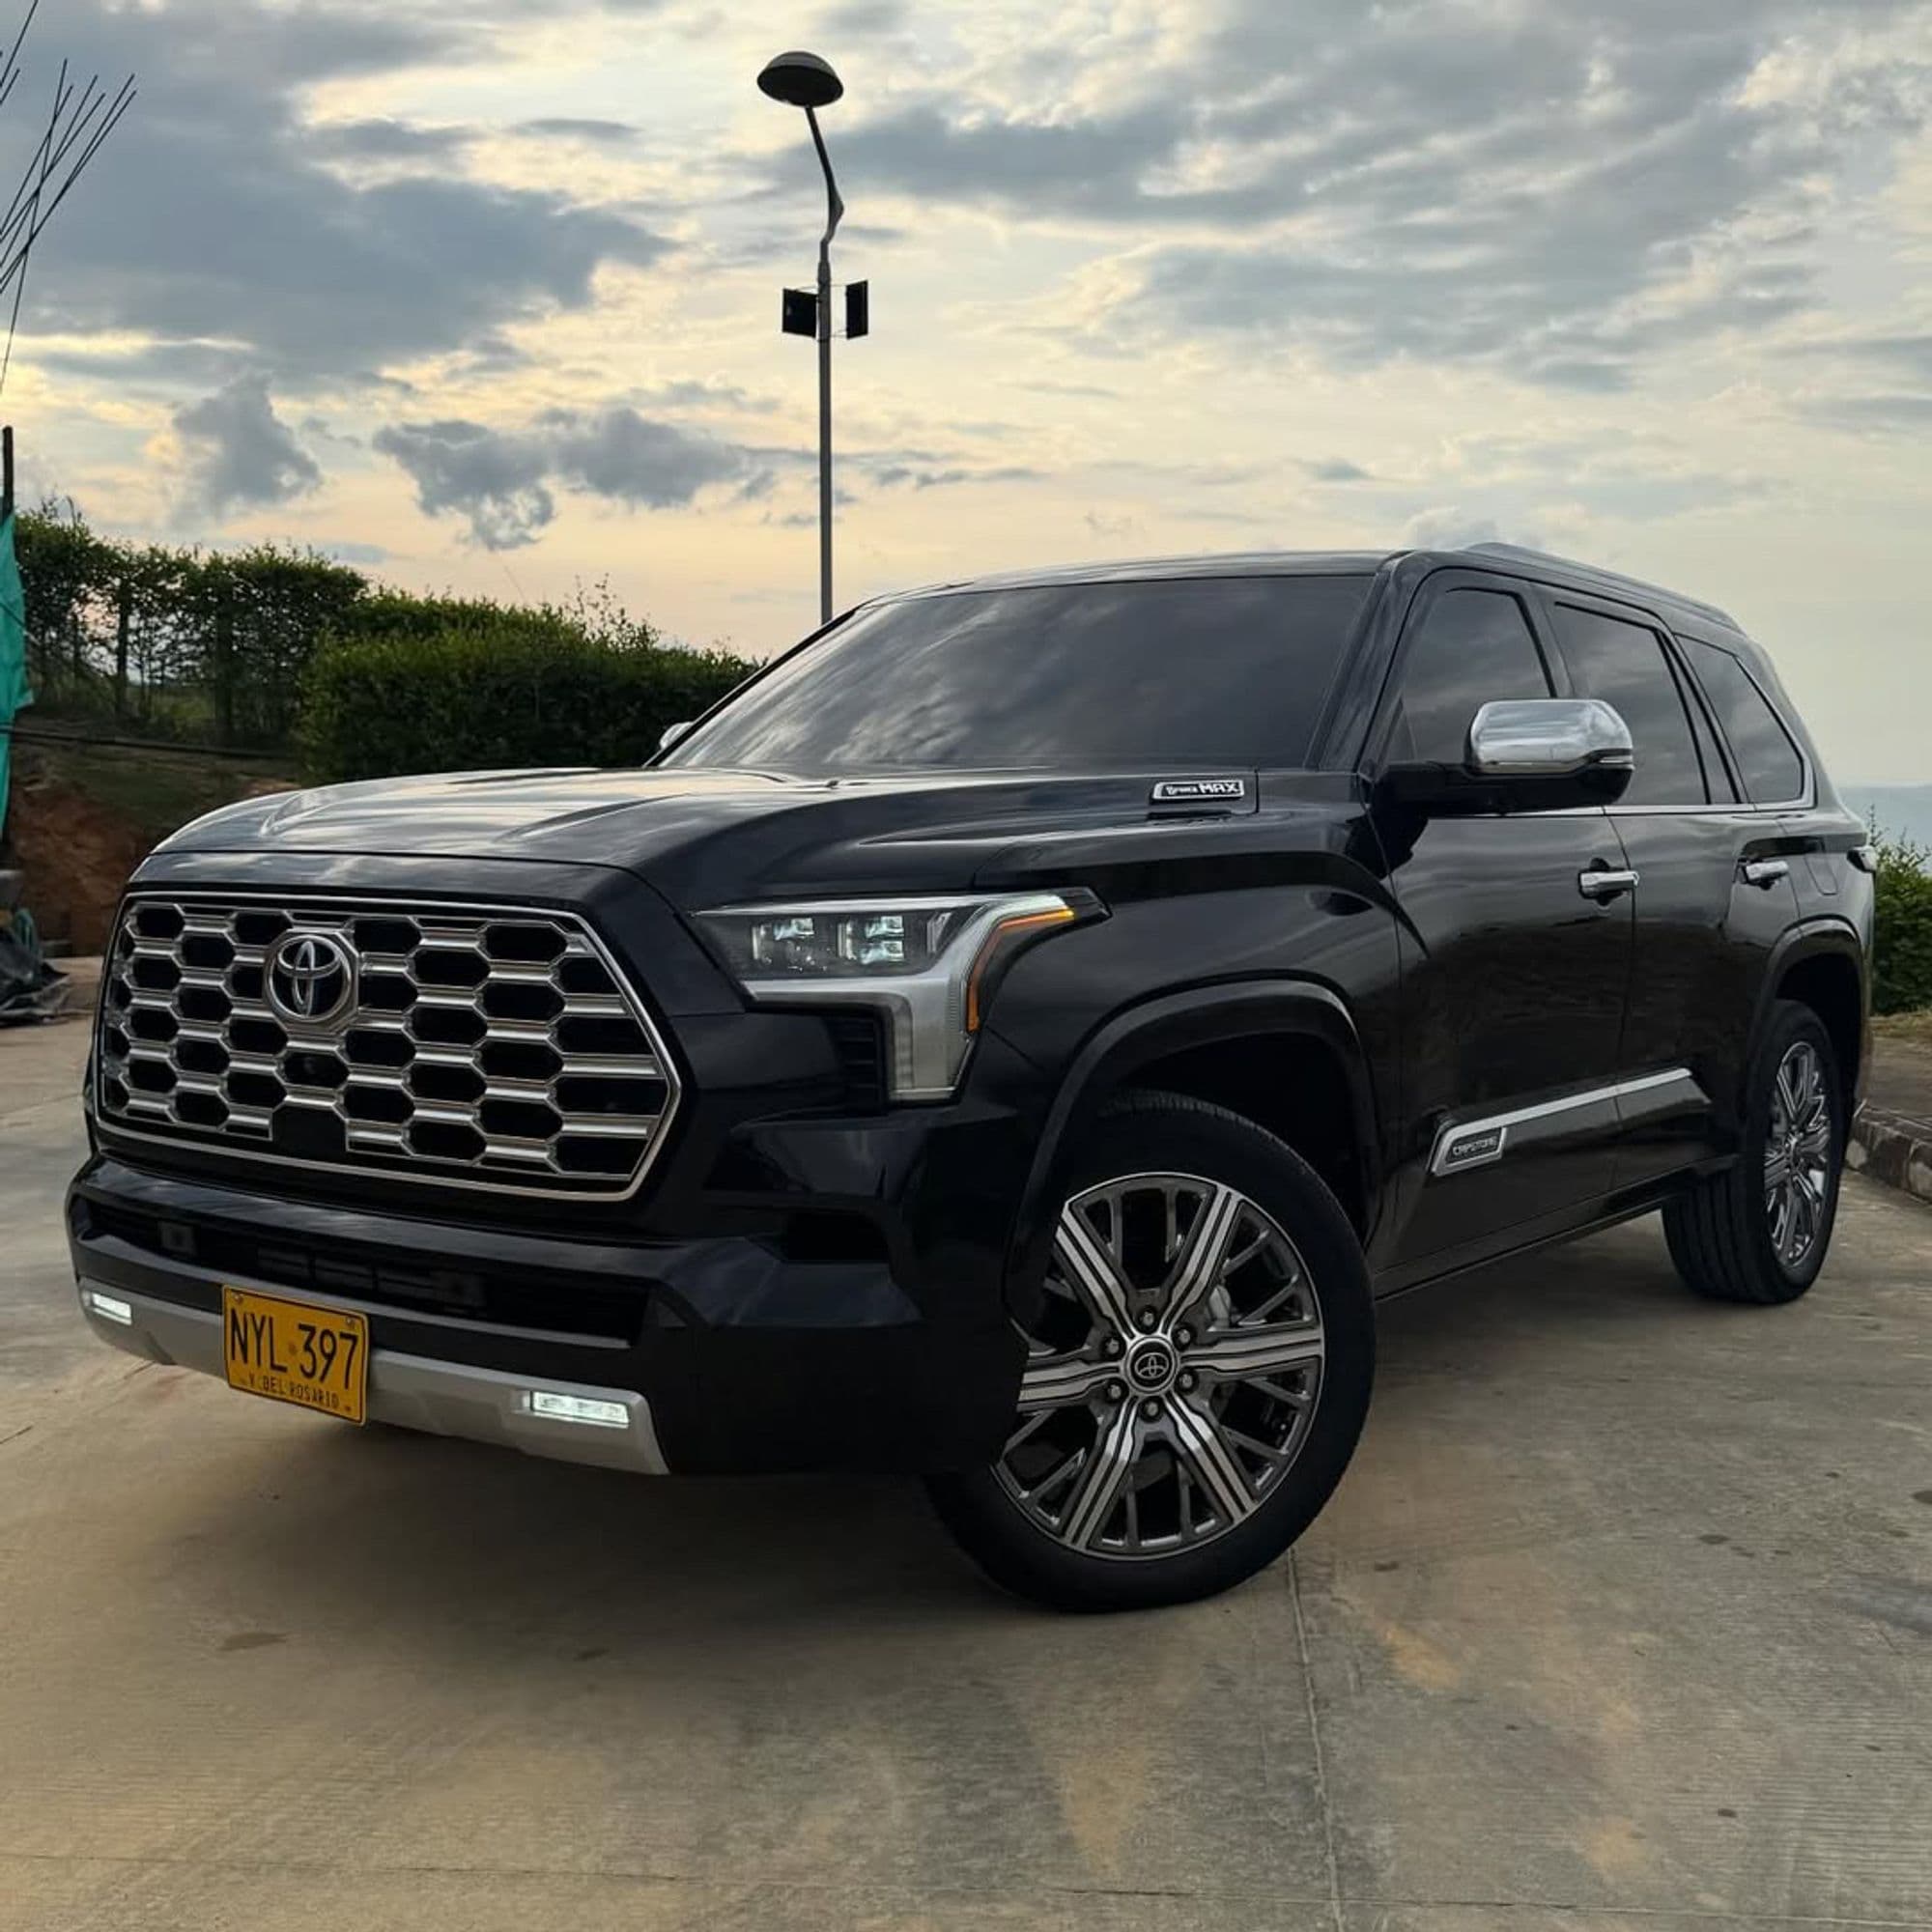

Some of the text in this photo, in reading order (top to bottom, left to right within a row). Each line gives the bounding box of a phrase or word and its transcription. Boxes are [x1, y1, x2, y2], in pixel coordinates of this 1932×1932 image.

[1200, 782, 1238, 794] MAX
[231, 1308, 358, 1390] NYL 397
[263, 1376, 287, 1394] DEL
